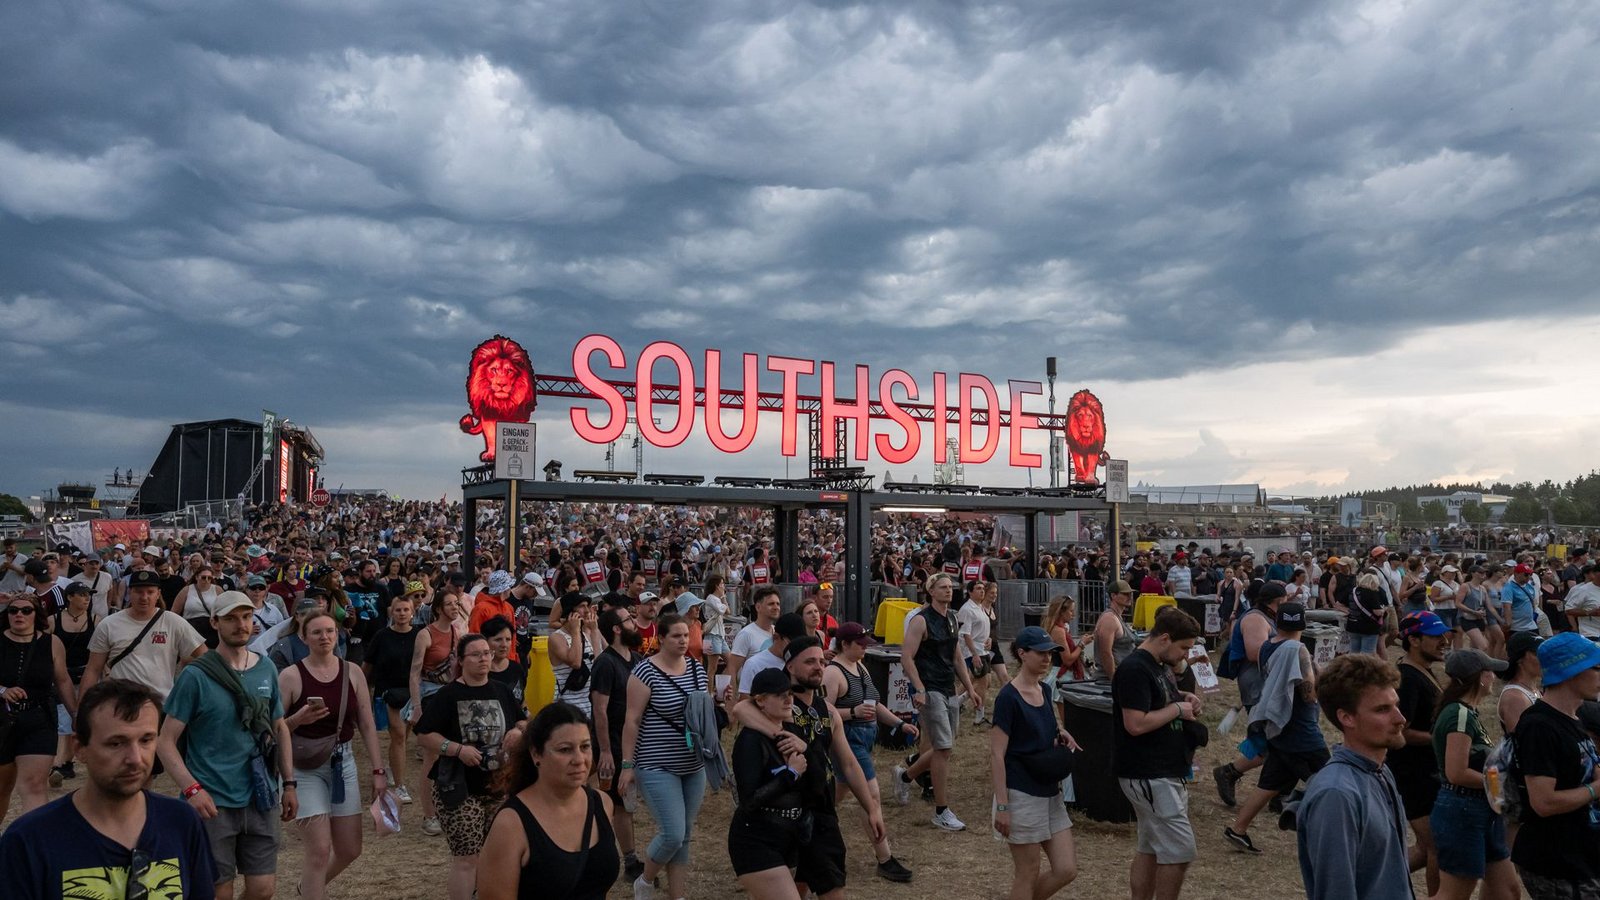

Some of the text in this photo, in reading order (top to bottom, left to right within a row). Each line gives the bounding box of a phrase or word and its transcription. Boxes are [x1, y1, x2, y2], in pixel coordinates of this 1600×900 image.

[570, 333, 1043, 468] SOUTHSIDE
[502, 427, 530, 438] EINGANG
[313, 494, 329, 502] STOP
[893, 679, 908, 688] SPE
